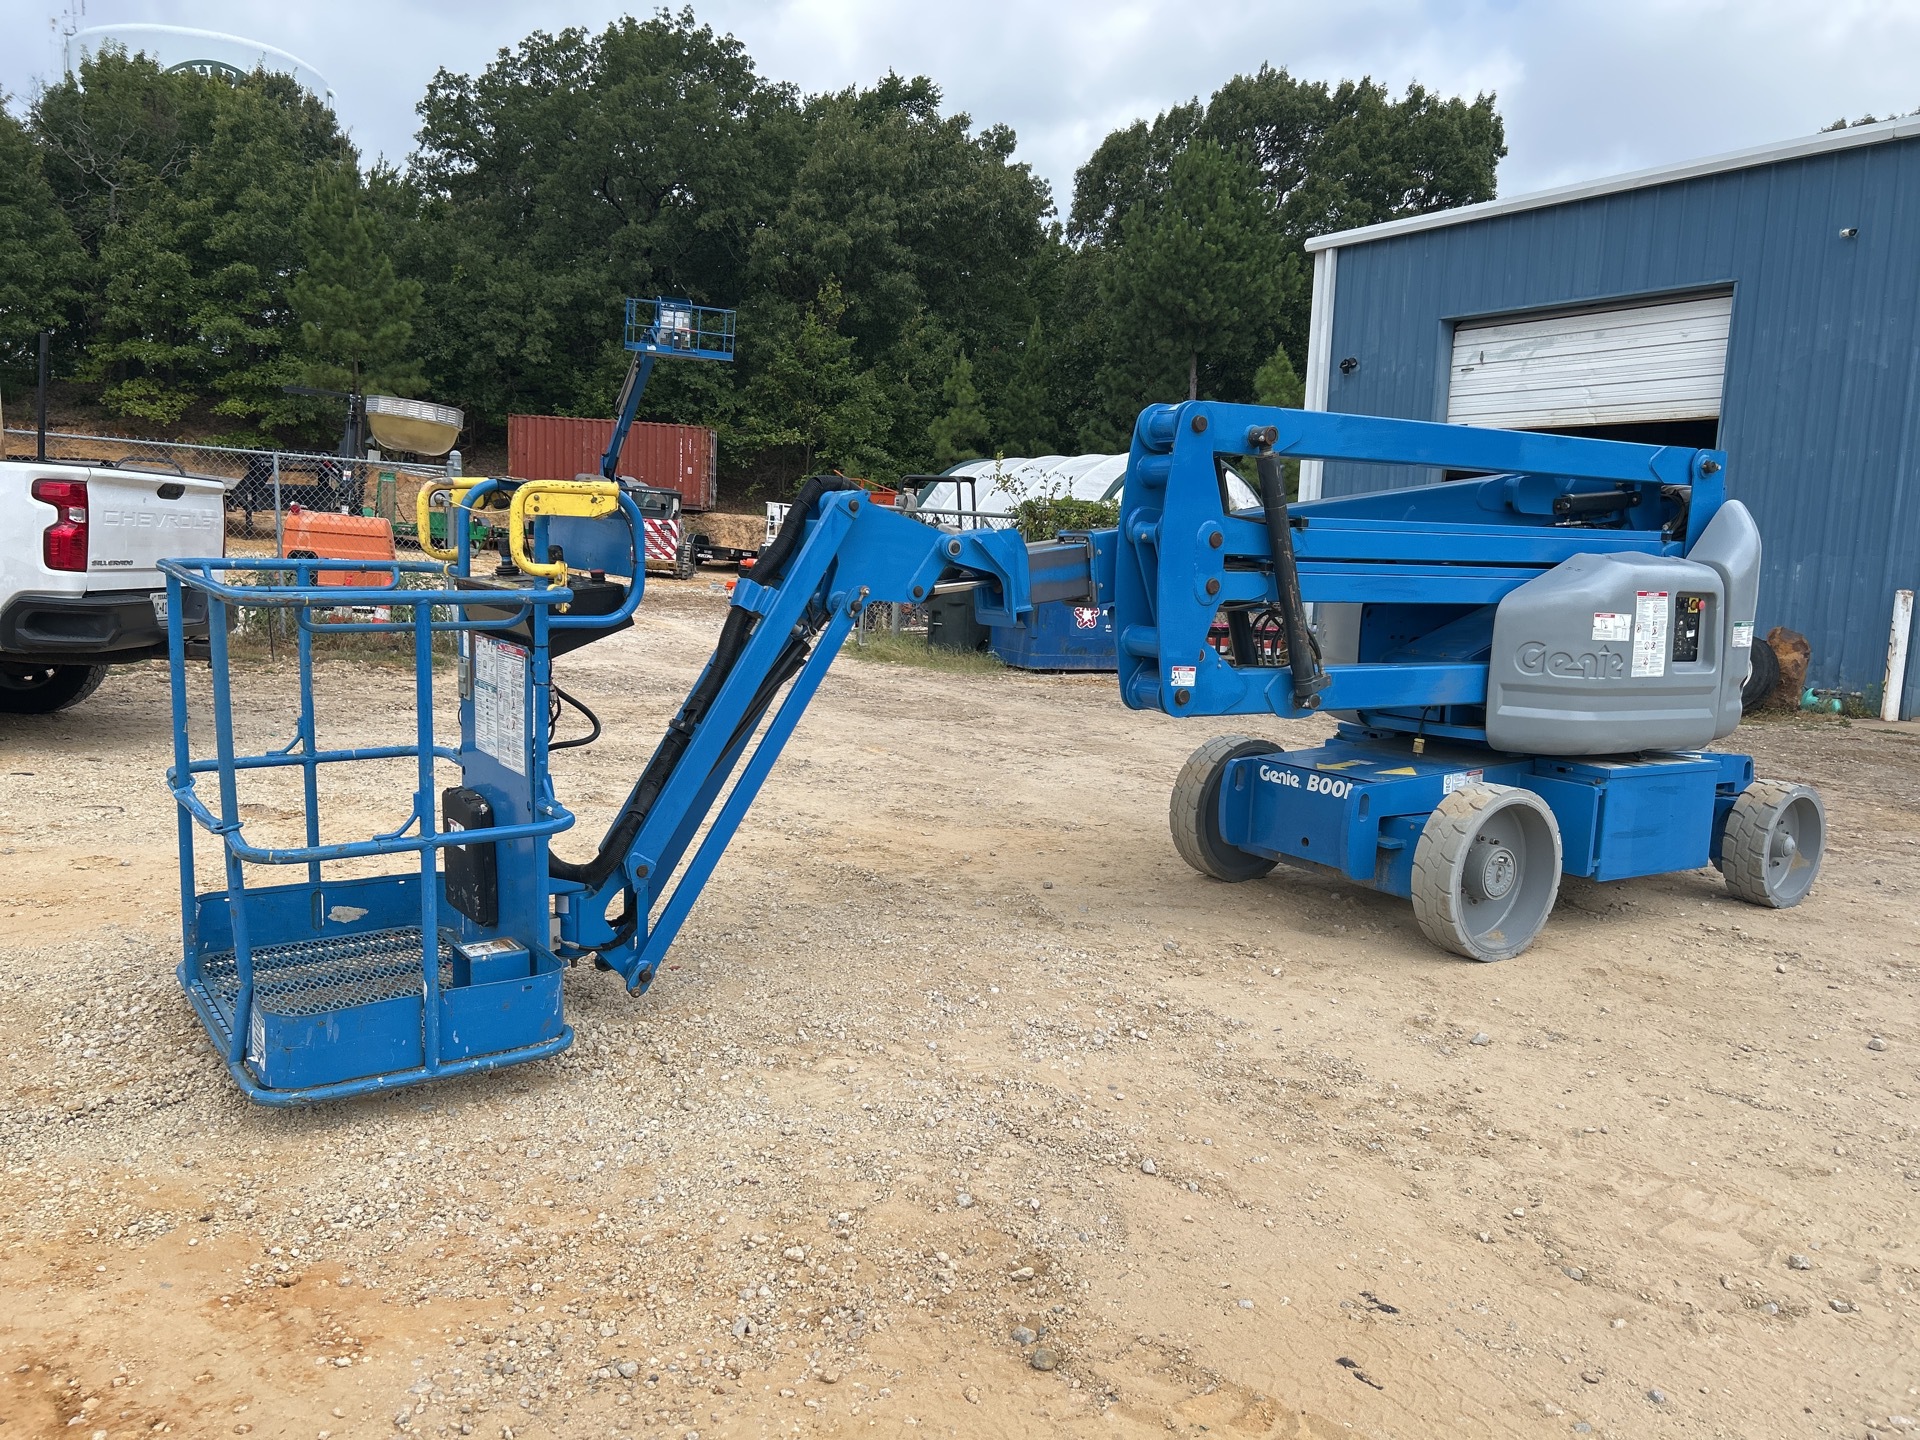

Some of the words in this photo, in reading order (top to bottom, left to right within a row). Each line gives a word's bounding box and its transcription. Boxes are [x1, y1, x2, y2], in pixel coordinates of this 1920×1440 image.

[103, 509, 220, 530] CHEVROLET
[1513, 641, 1624, 680] Genie
[1259, 764, 1301, 789] Genie
